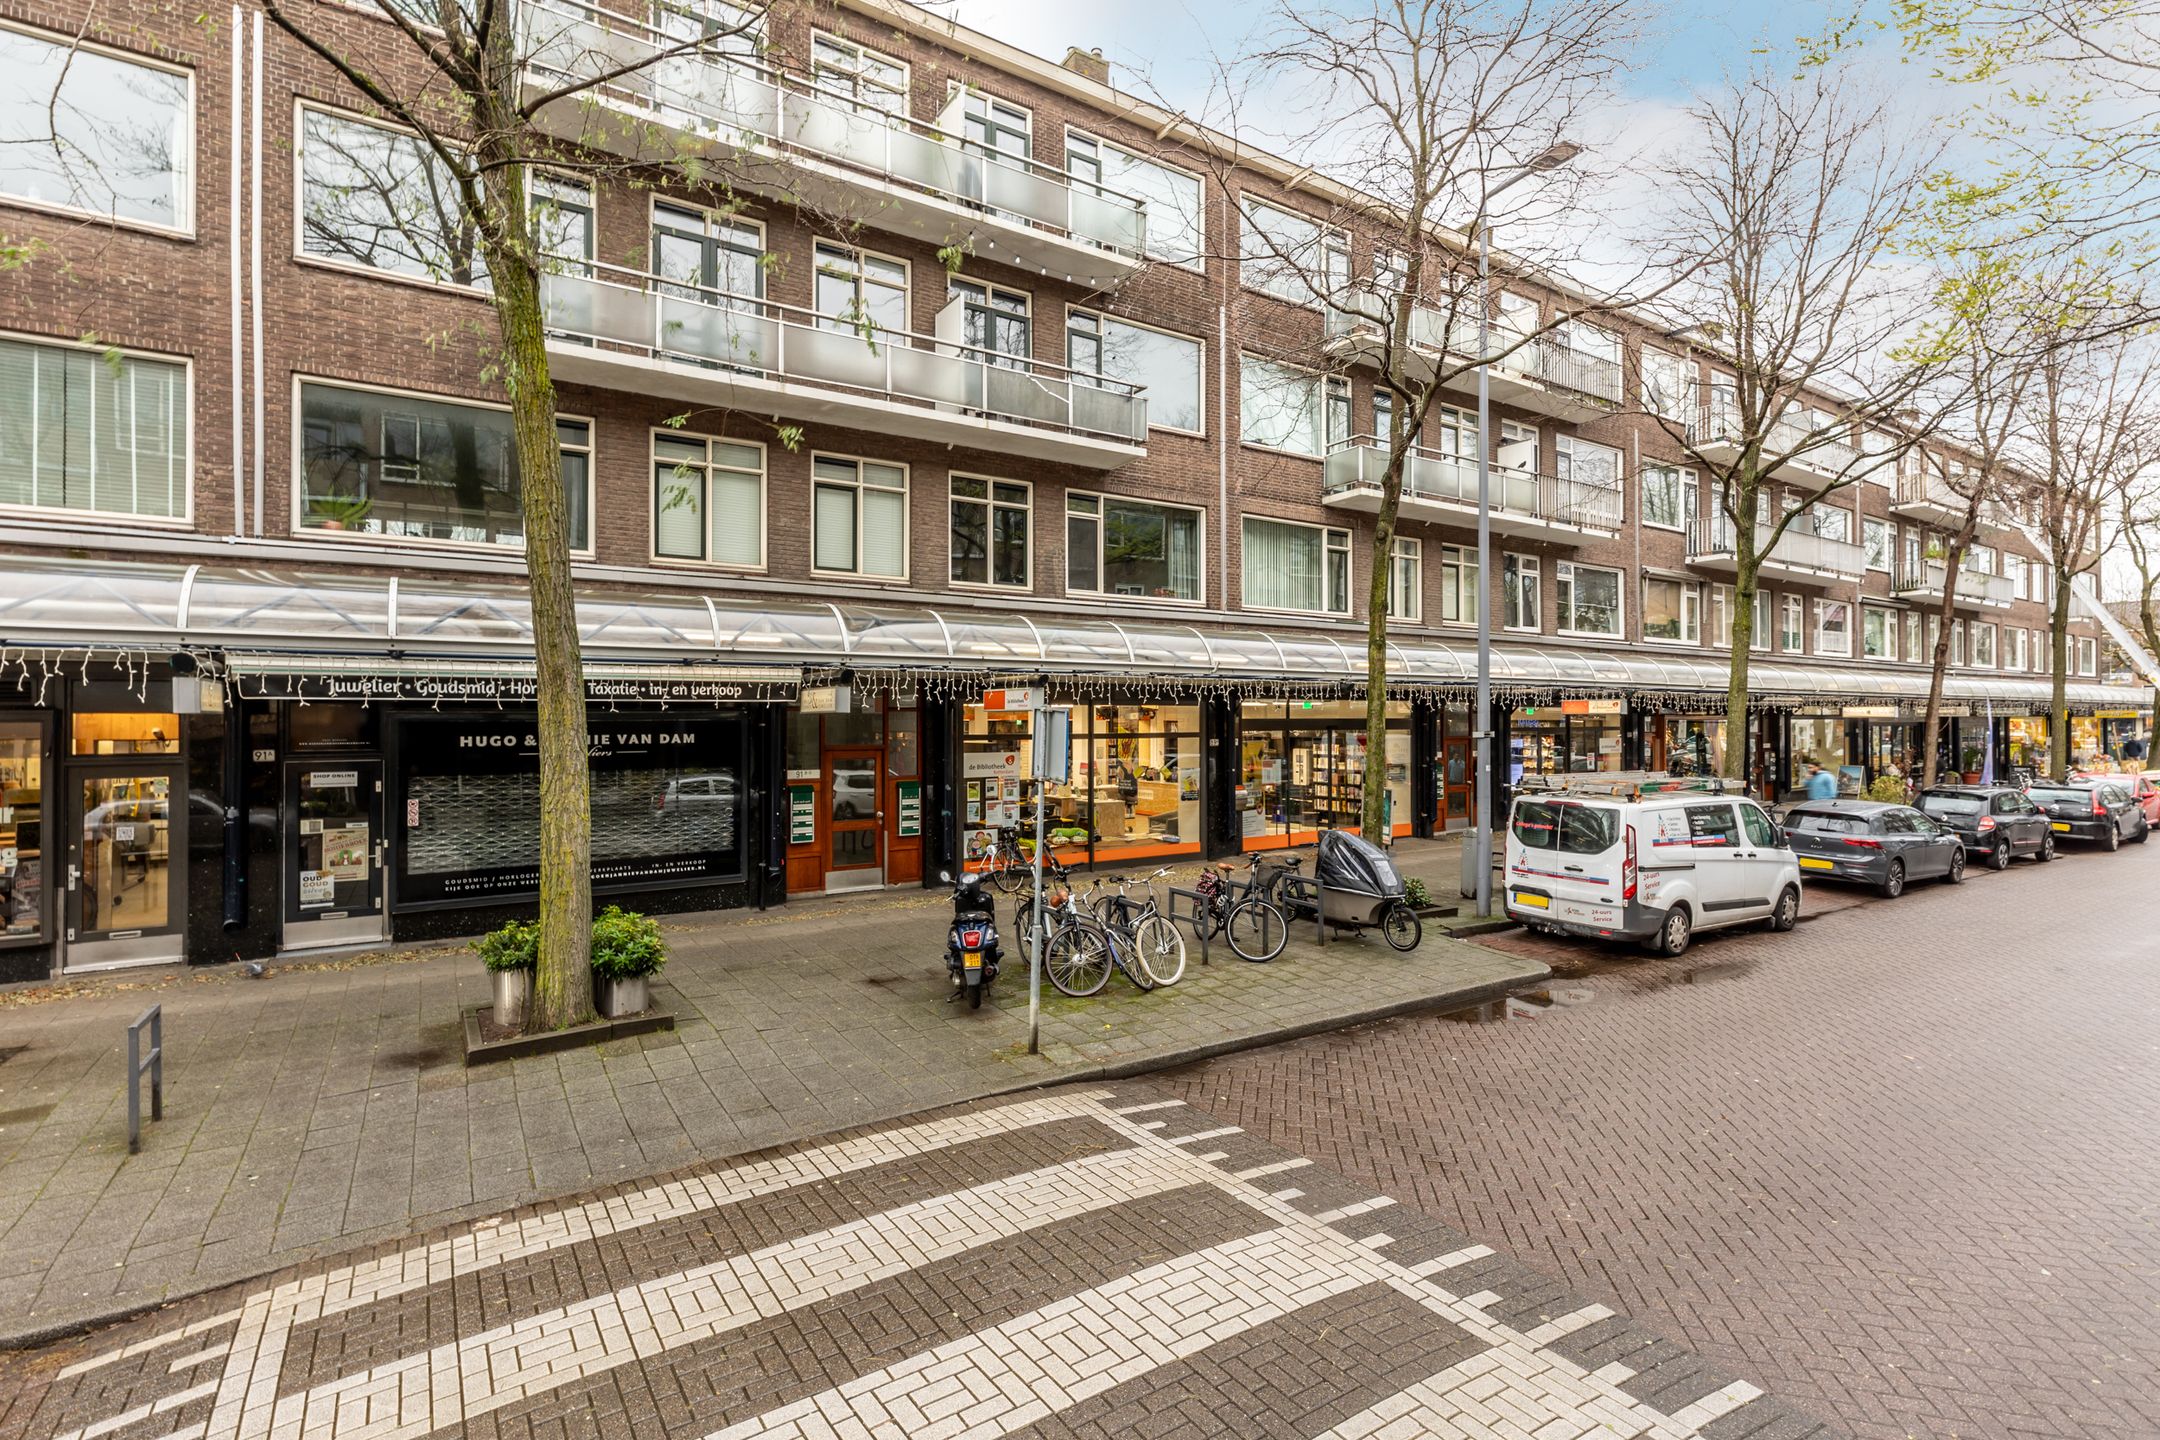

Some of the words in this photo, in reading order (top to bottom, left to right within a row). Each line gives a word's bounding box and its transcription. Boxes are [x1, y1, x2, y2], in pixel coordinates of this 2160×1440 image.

[327, 679, 401, 696] Juwelier
[417, 680, 496, 696] Goudsmid
[511, 681, 538, 694] Hor
[588, 682, 637, 696] Taxatie
[672, 684, 688, 695] en
[692, 683, 743, 699] verkoop
[460, 735, 517, 747] HUGO
[524, 735, 537, 747] &
[617, 733, 652, 745] VAN
[659, 733, 695, 744] DAM
[444, 876, 488, 886] GOUDSMID
[496, 880, 517, 888] ONZE
[1644, 881, 1660, 890] Service
